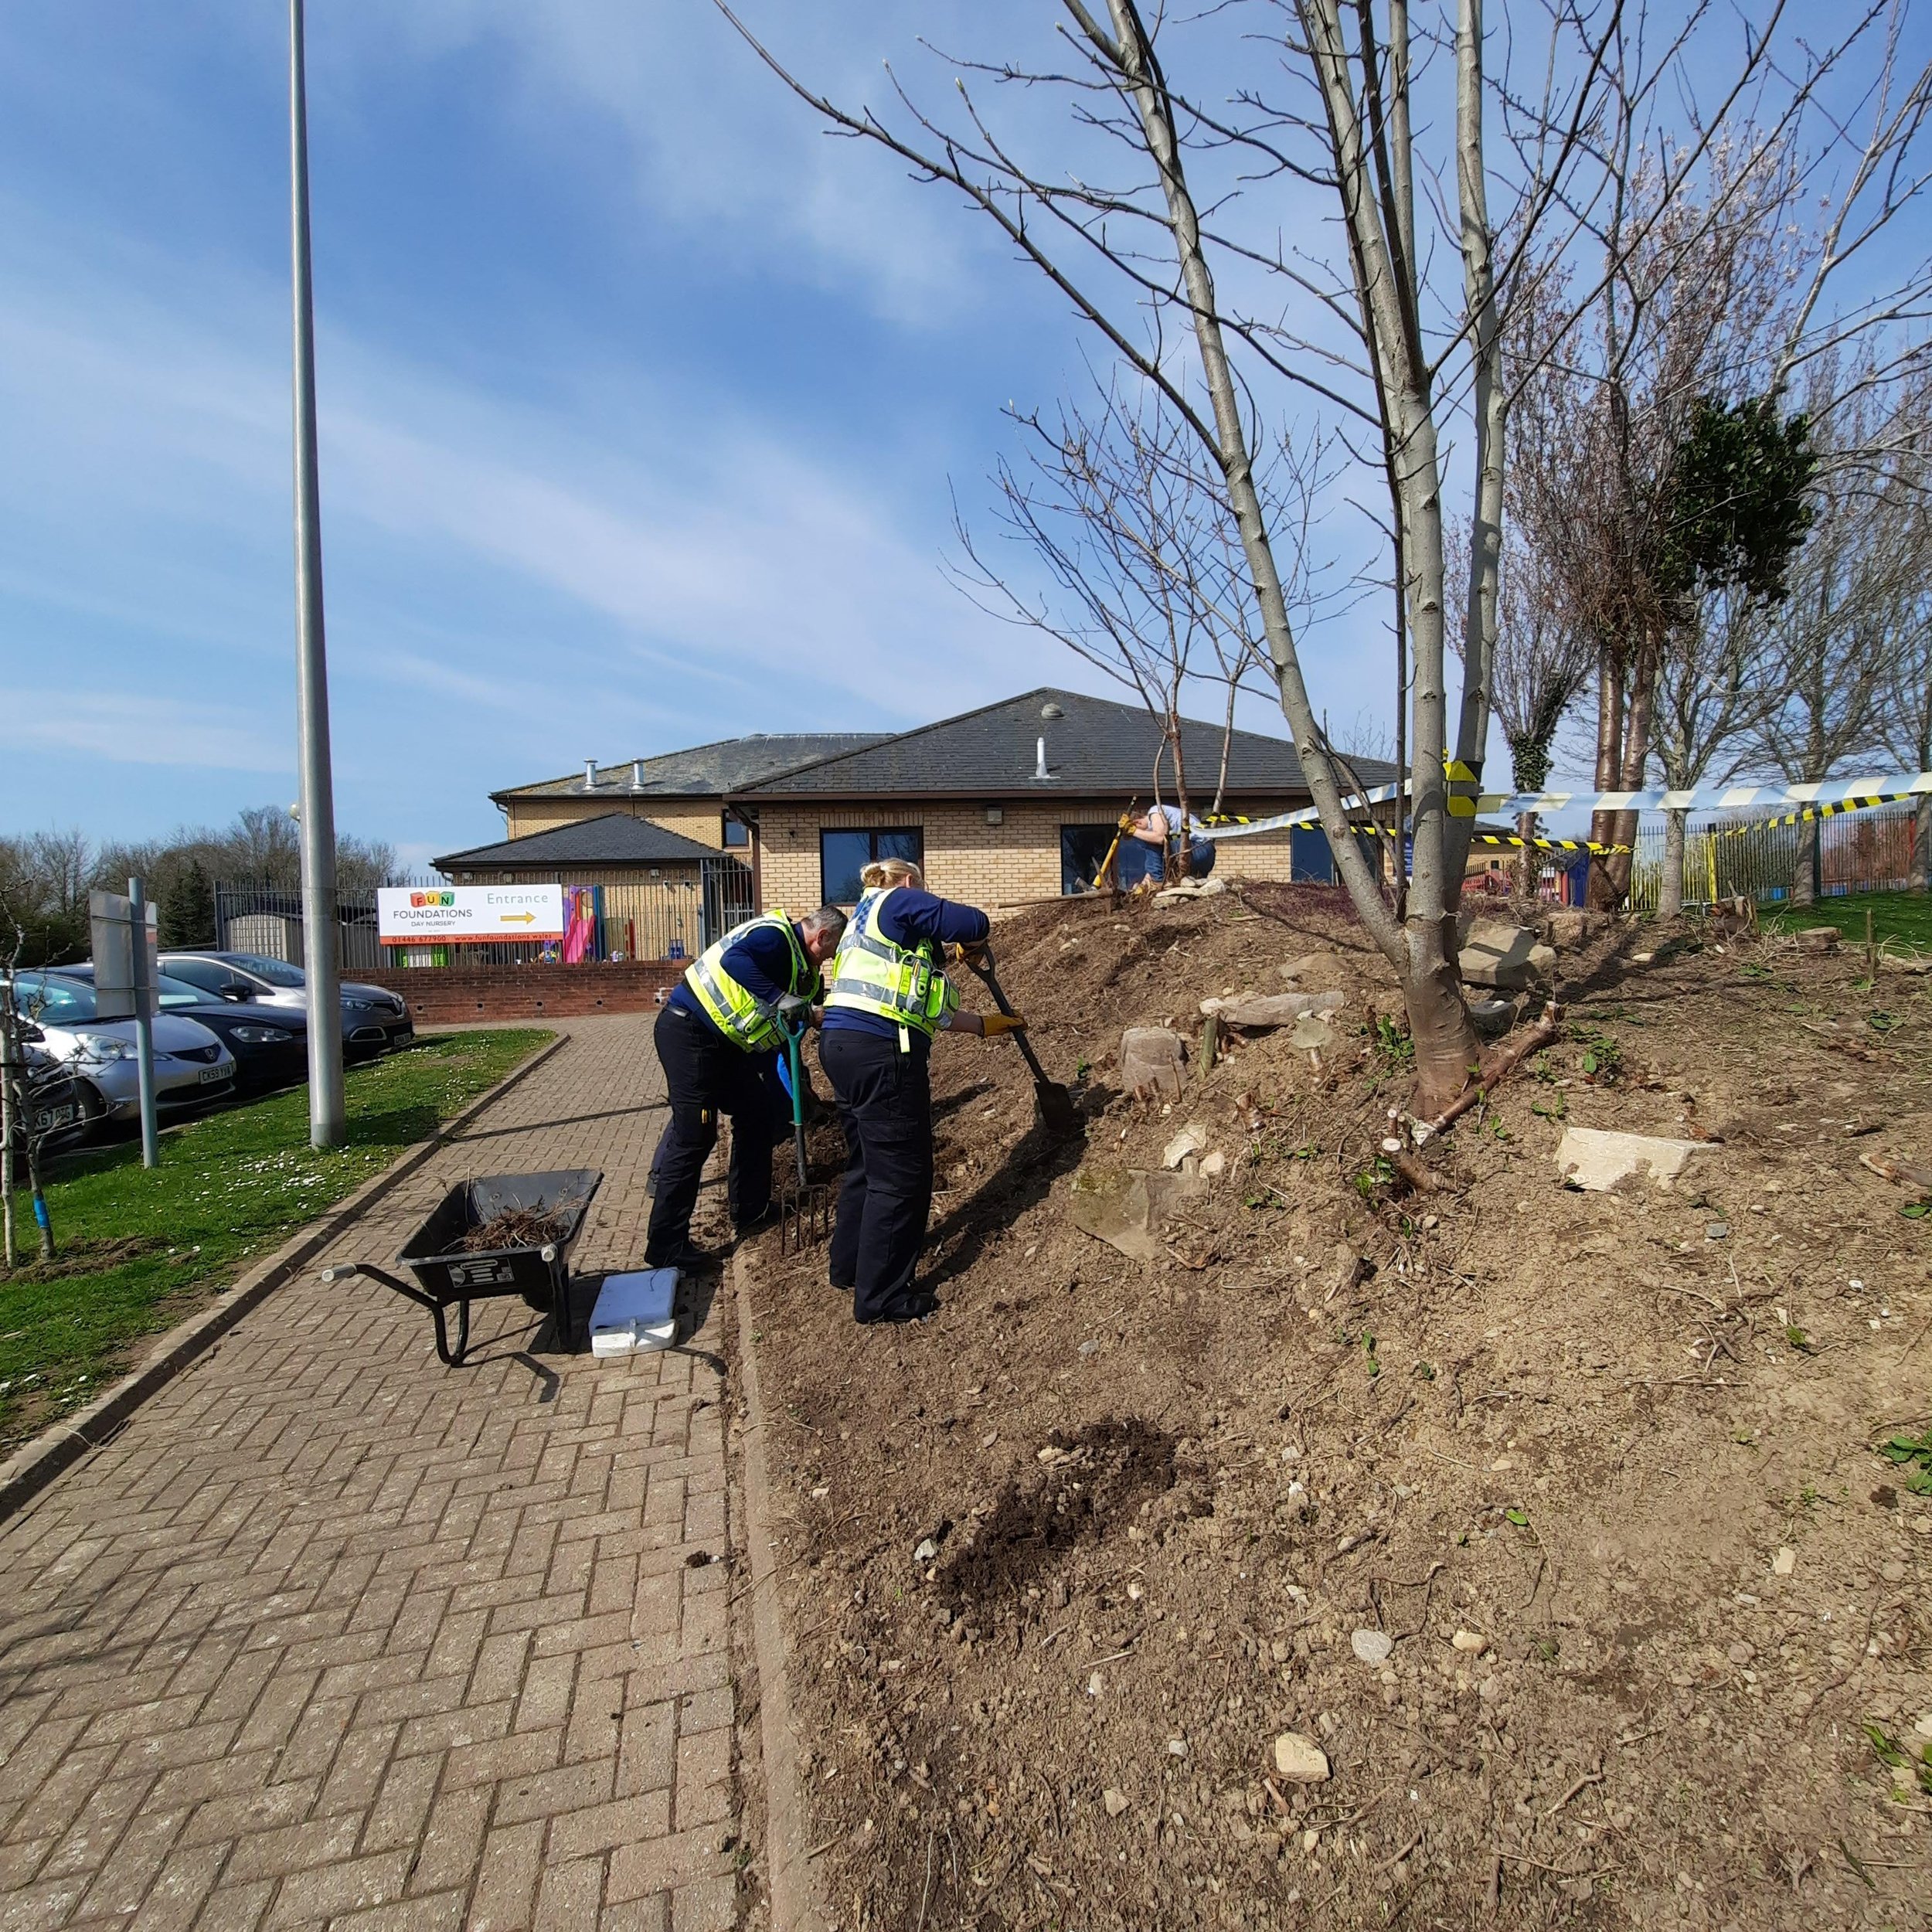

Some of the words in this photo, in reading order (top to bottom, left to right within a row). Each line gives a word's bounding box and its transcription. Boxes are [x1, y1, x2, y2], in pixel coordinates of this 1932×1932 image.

[417, 896, 449, 906] FUN
[487, 893, 549, 904] Entrance
[393, 909, 473, 919] FOUNDATIONS
[35, 1111, 53, 1127] K67
